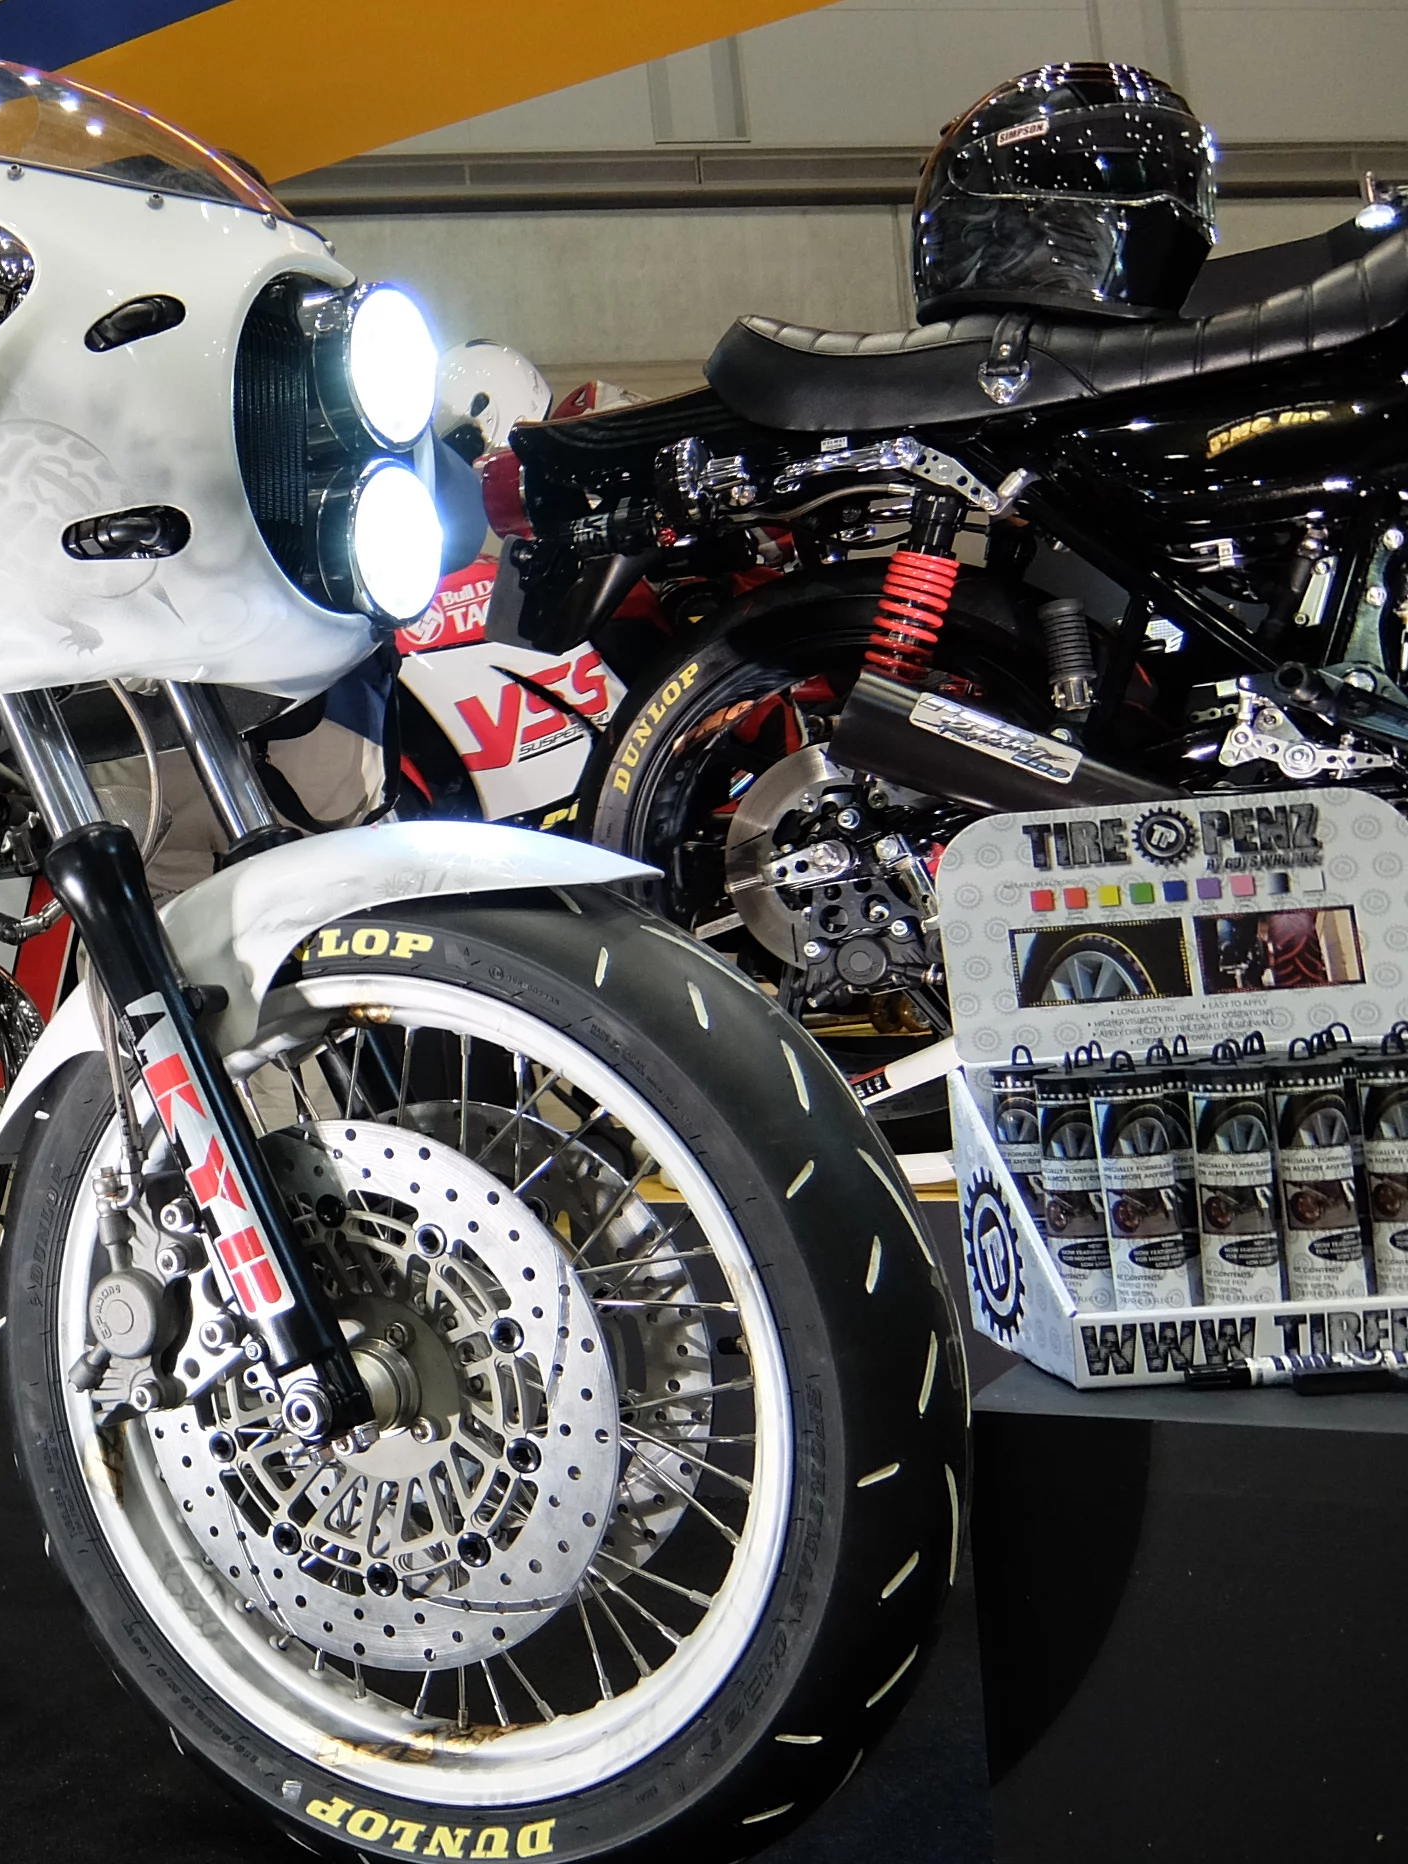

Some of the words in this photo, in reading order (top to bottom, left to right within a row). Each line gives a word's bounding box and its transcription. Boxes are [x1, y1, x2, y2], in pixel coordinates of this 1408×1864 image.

[1000, 123, 1044, 143] SIMPSON
[441, 583, 473, 606] Bull
[613, 662, 699, 796] DUNLOP
[1022, 817, 1130, 870] TIRE
[1199, 803, 1322, 855] PENZ
[1117, 1007, 1140, 1016] LONG
[1141, 1005, 1176, 1014] LASTING
[1208, 1000, 1229, 1009] EASY
[1230, 999, 1242, 1008] TO
[1243, 998, 1268, 1007] APPLY
[143, 1051, 283, 1314] KYB
[305, 1795, 556, 1860] DUNLOP
